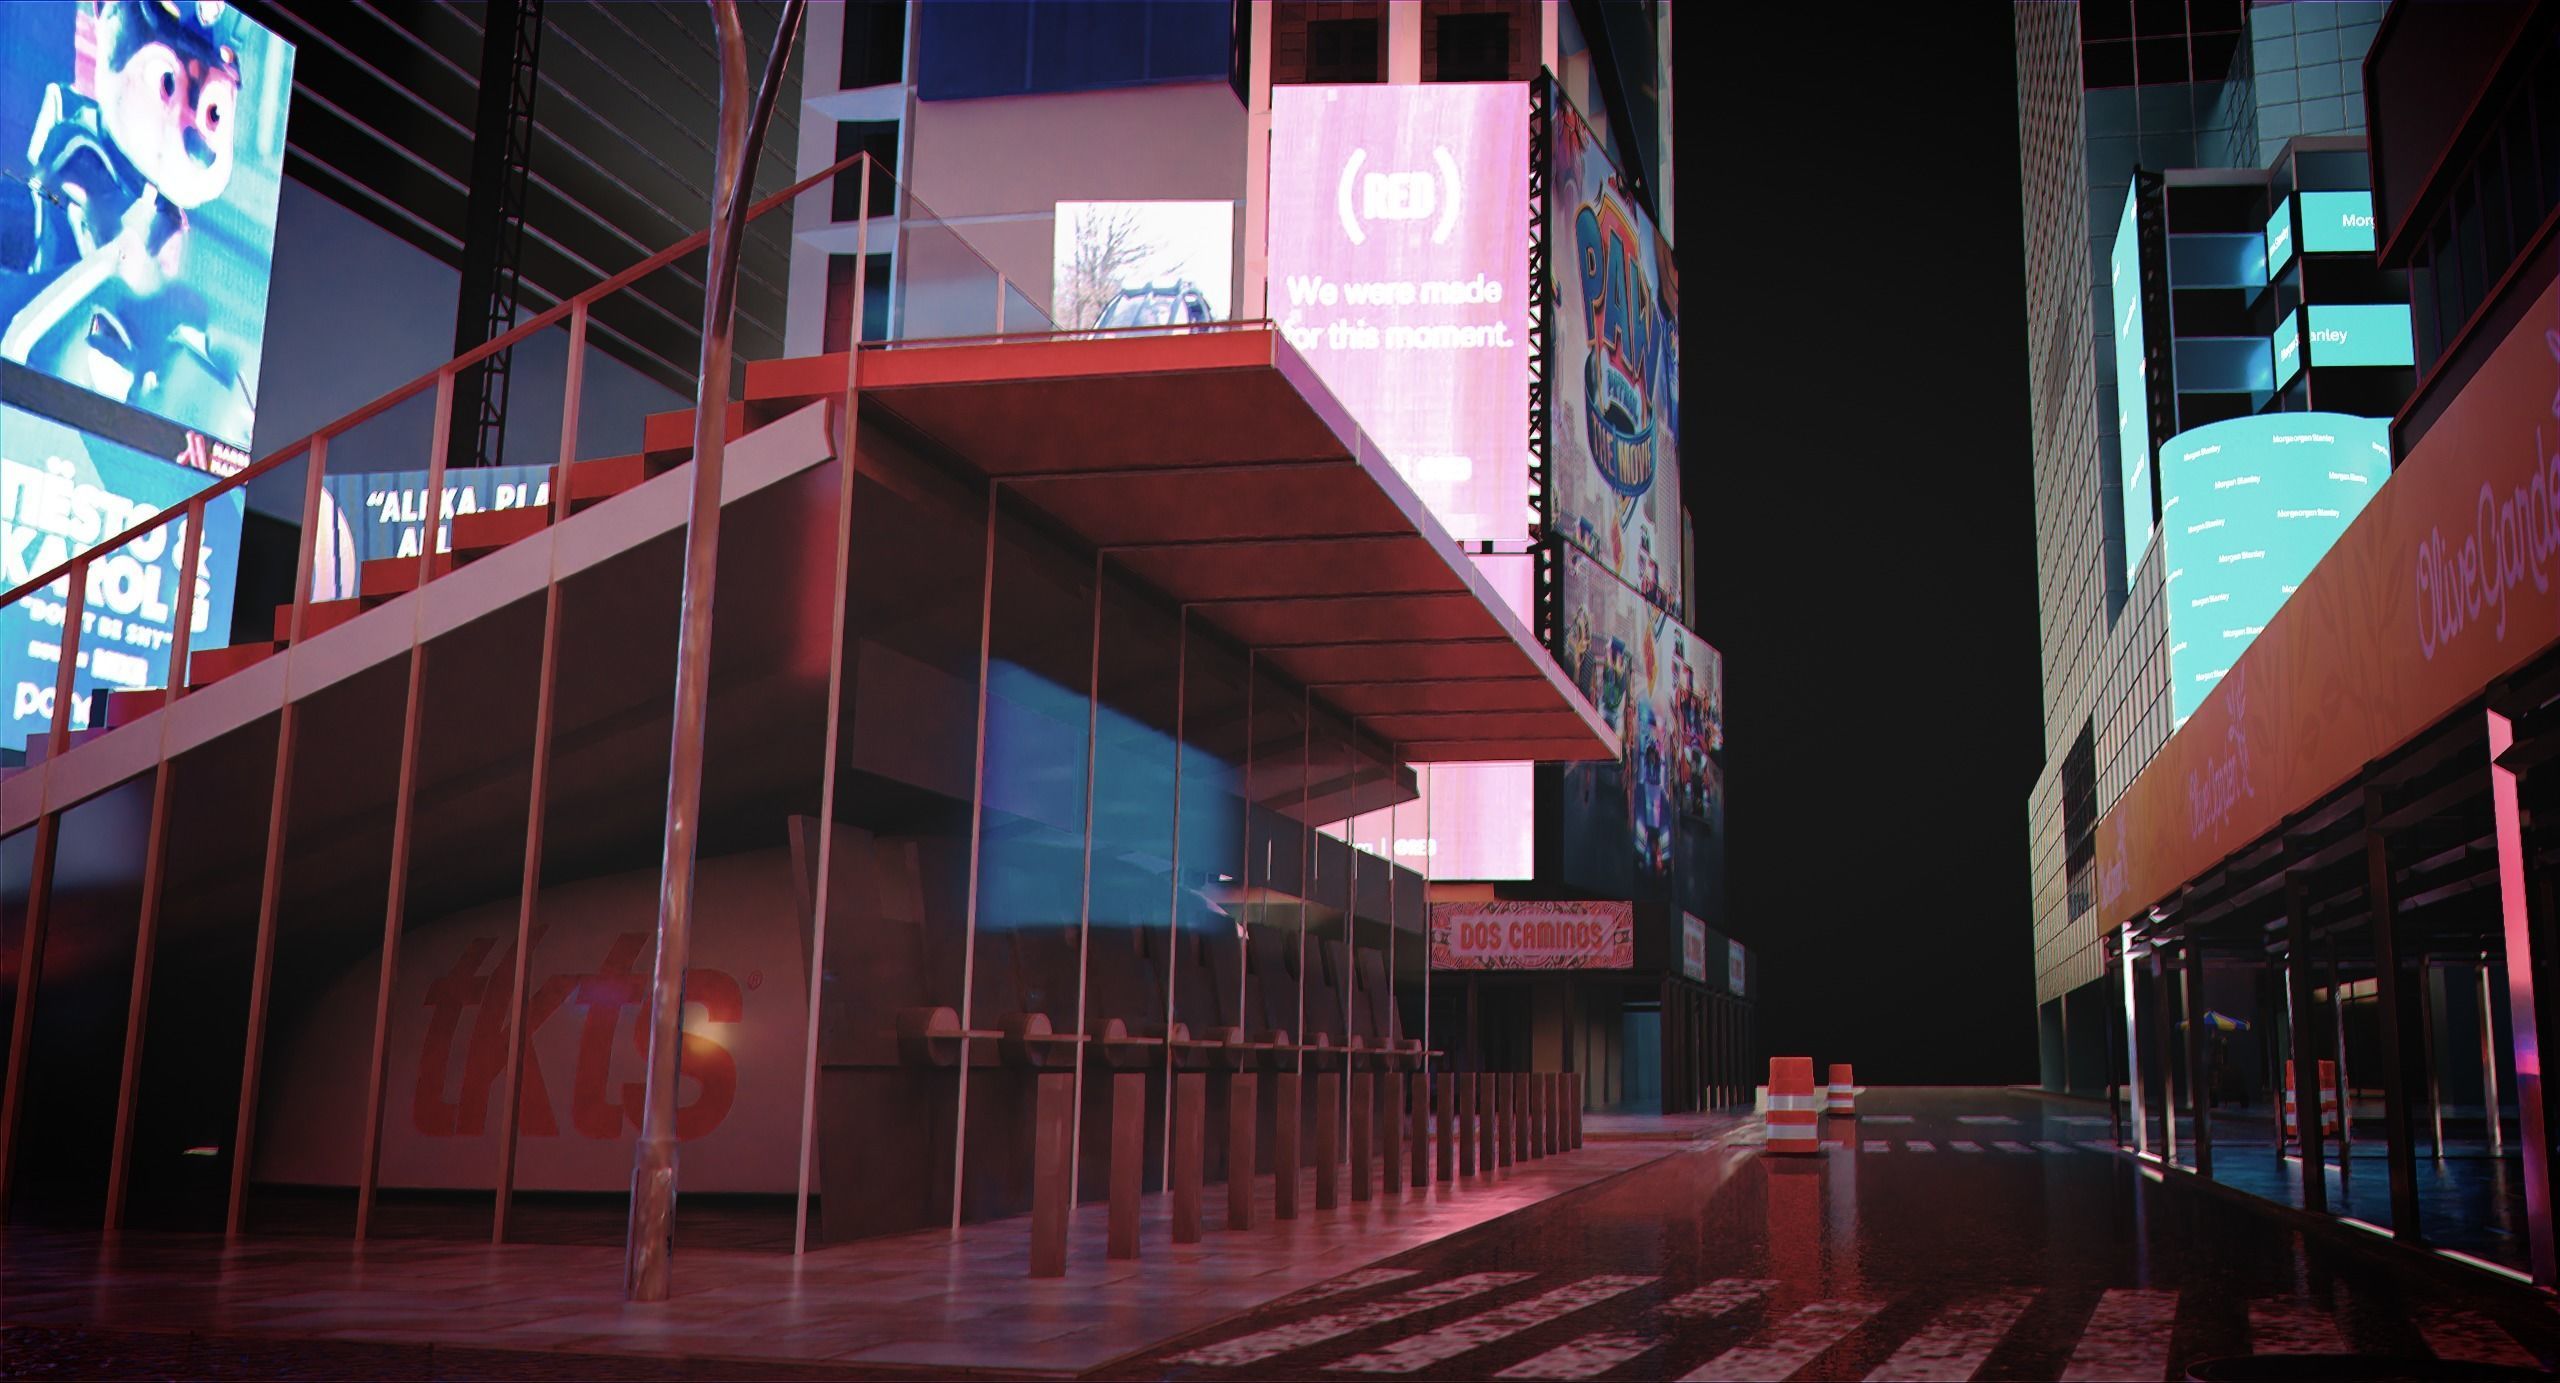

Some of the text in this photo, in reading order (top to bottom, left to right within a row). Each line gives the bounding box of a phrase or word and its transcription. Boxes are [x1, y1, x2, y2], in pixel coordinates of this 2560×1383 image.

[1286, 272, 1503, 306] We were made
[1574, 201, 1664, 408] PAW
[1327, 318, 1380, 350] this
[1384, 320, 1515, 350] moment.
[396, 526, 452, 559] AL
[2416, 525, 2481, 661] Olive
[1460, 921, 1604, 951] DOS CAMINOS
[412, 924, 743, 1142] tkts
